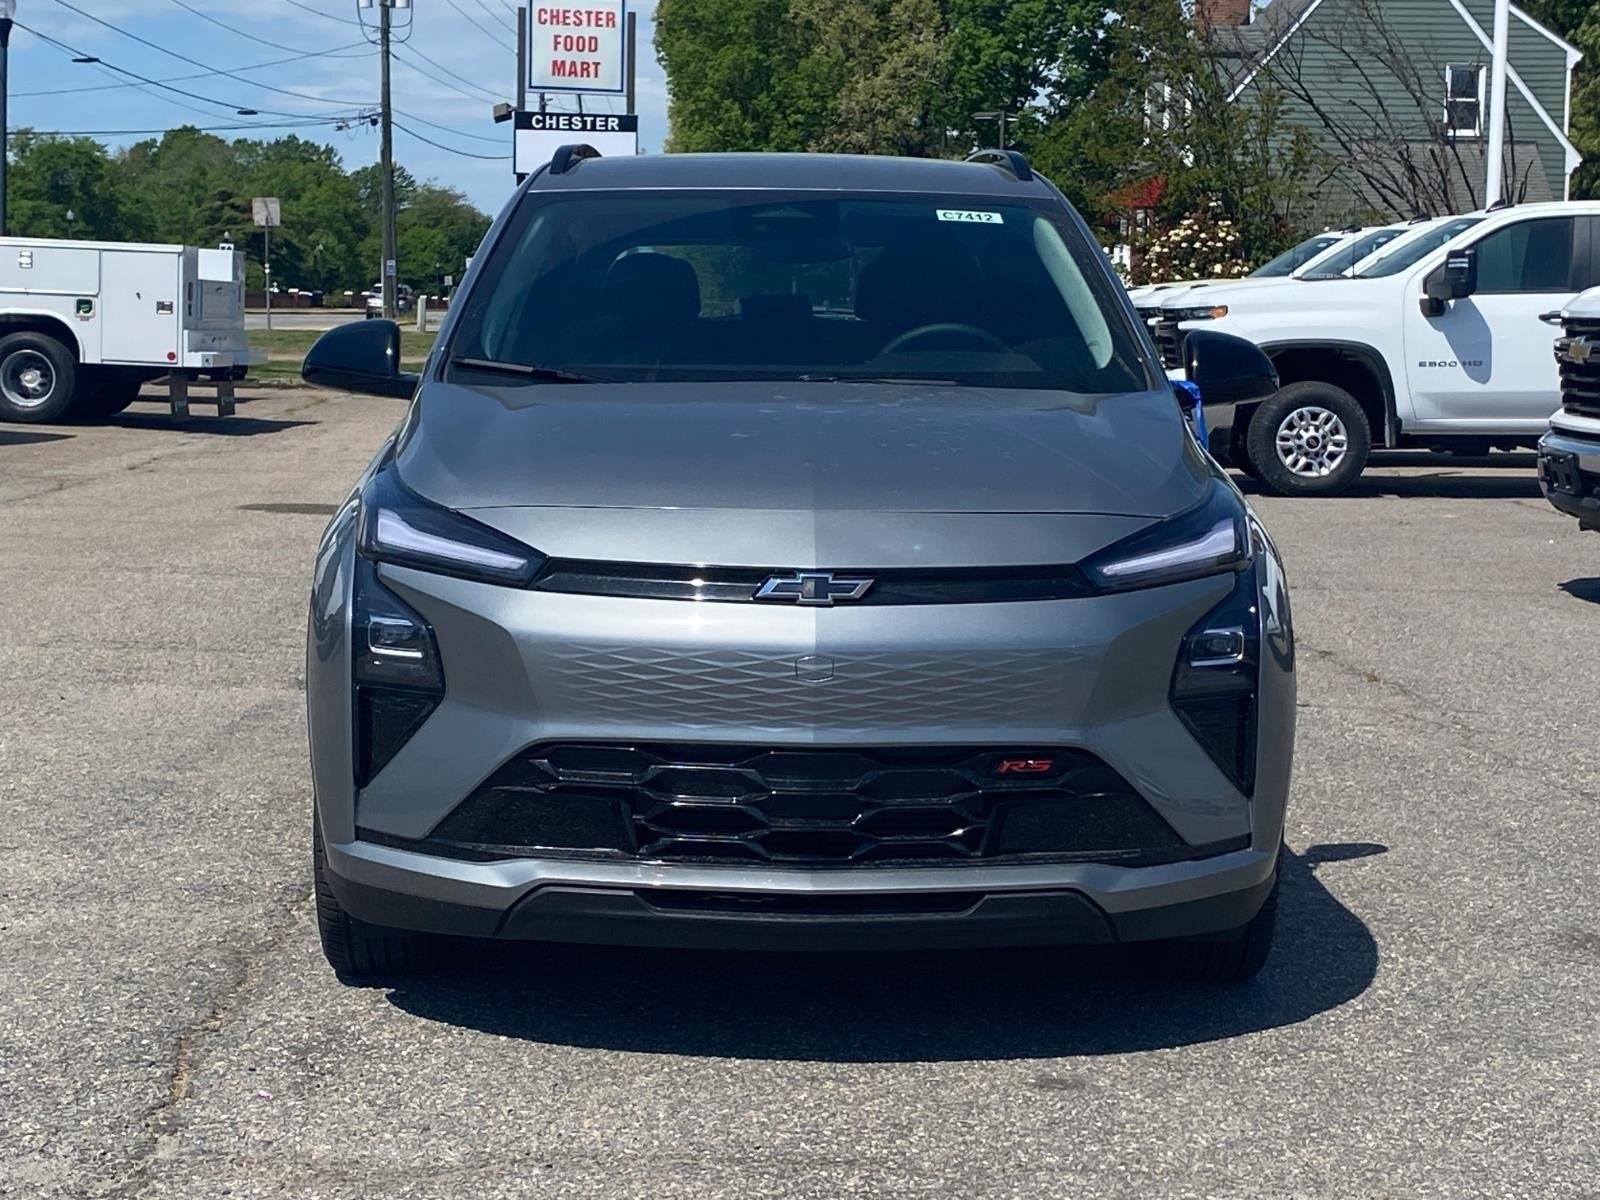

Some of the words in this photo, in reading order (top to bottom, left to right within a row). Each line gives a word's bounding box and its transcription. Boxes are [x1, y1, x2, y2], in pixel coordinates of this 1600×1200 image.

[537, 8, 616, 28] CHESTER
[553, 34, 599, 53] FOOD
[551, 60, 601, 78] MART
[531, 115, 620, 131] CHESTER
[942, 211, 993, 221] C7412
[1461, 360, 1483, 368] HD
[997, 760, 1053, 773] RS
